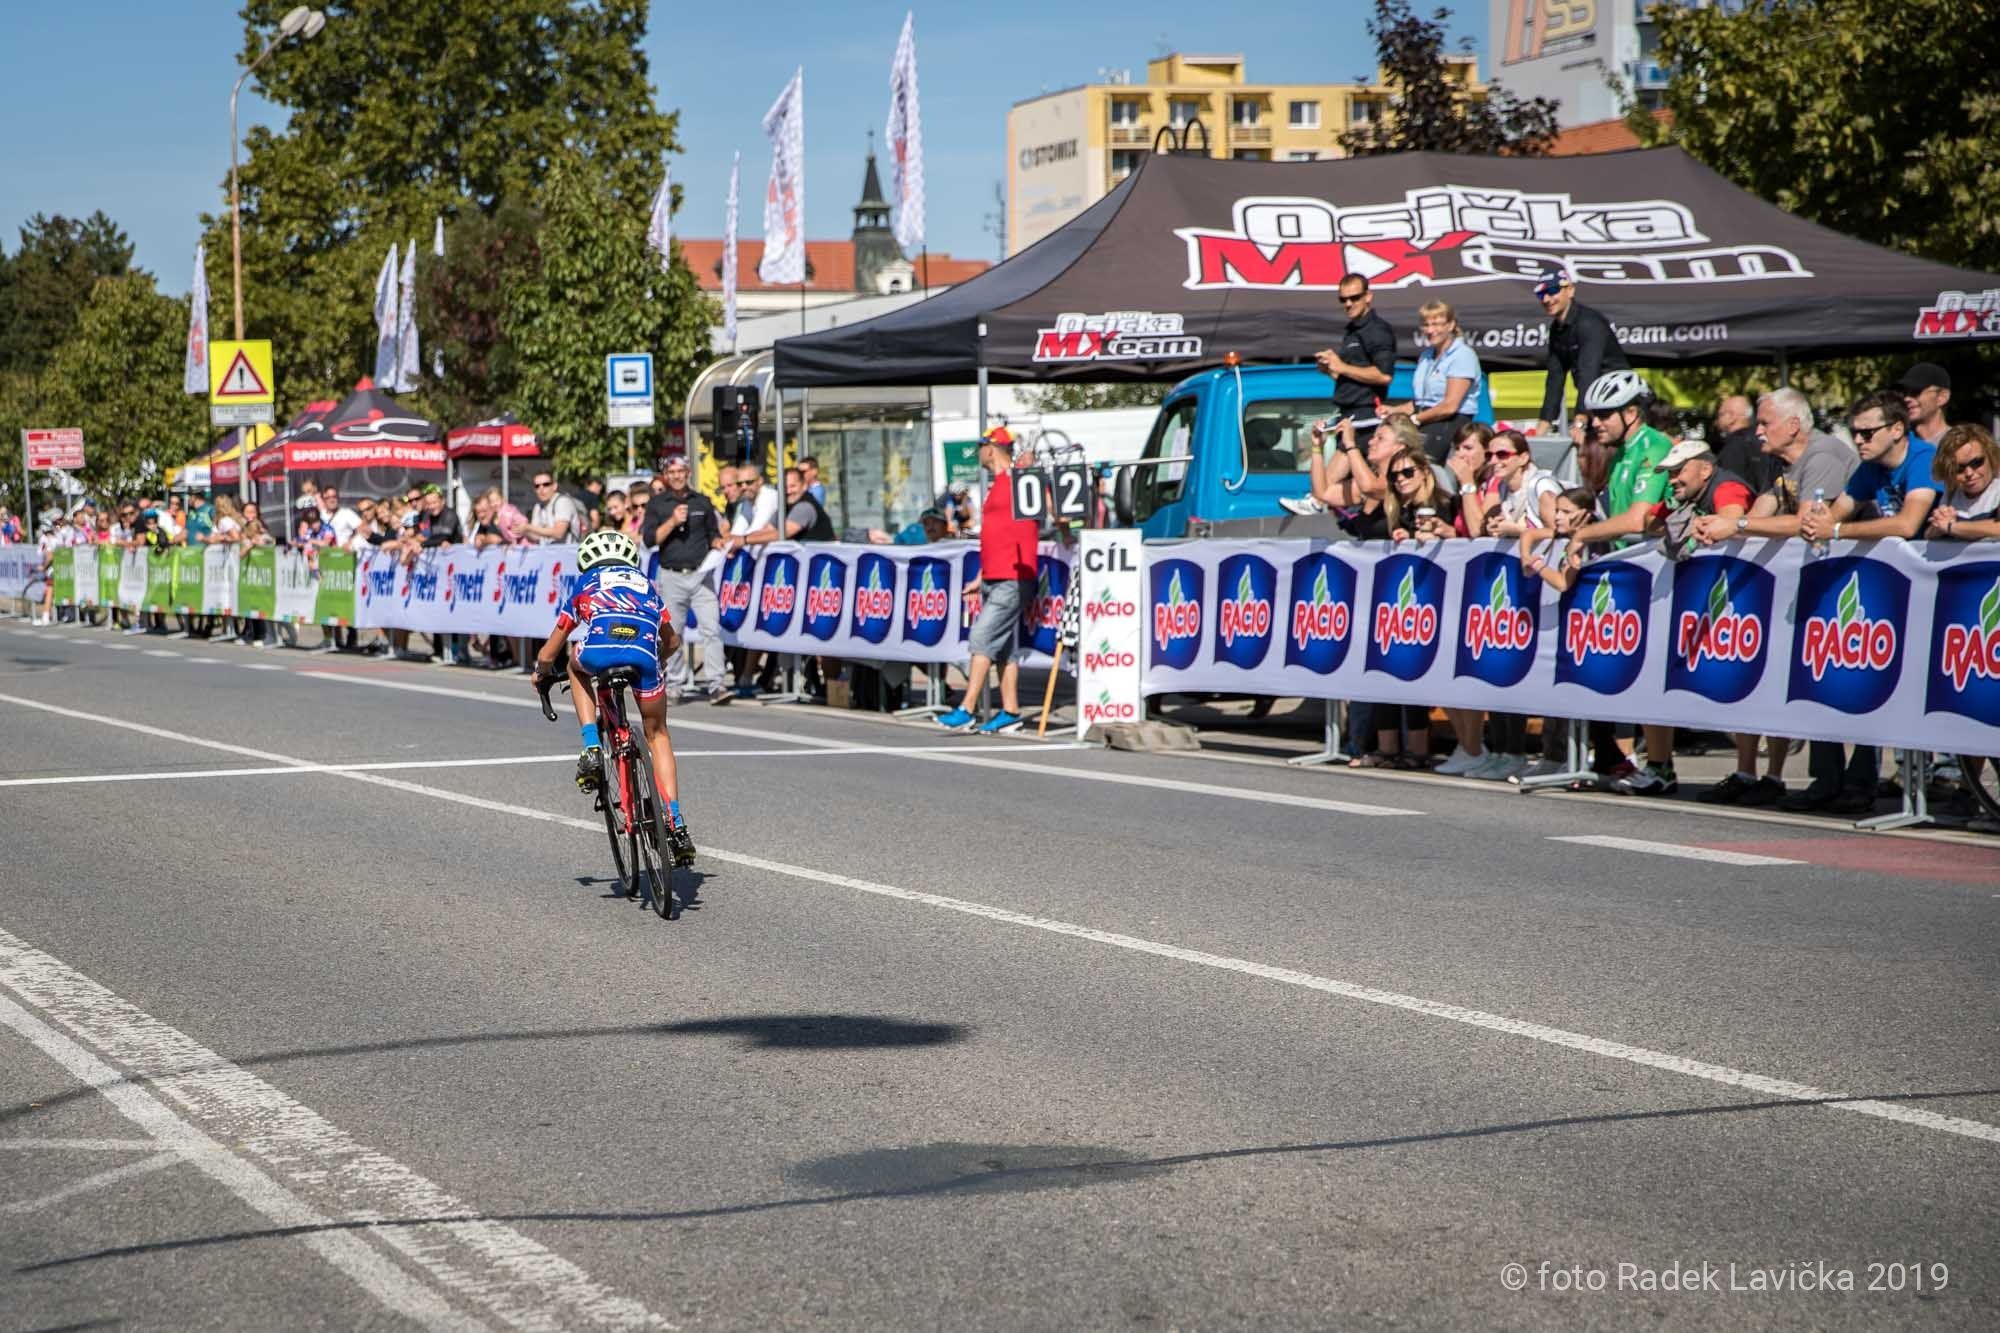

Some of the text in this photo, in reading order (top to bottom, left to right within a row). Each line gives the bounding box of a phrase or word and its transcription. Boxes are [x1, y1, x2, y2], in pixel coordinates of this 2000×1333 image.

[1238, 187, 1703, 248] Osička
[292, 447, 392, 462] SPORTCOMPLEX
[1018, 471, 1084, 516] 0 2
[1085, 542, 1136, 572] CÍL
[761, 584, 795, 621] RACIO
[807, 586, 842, 624] RACIO
[856, 587, 893, 626] RACIO
[908, 588, 947, 629] RACIO
[1086, 602, 1135, 623] RACIO
[1223, 600, 1270, 647] RACIO
[1155, 601, 1199, 650] RACIO
[1294, 601, 1349, 650] RACIO
[1375, 603, 1436, 656] RACIO
[1466, 605, 1533, 660] RACIO
[1567, 609, 1641, 666] RACIO
[1679, 611, 1762, 672] RACIO
[1085, 652, 1134, 672] RACIO
[1803, 617, 1896, 681] RACIO
[1084, 703, 1133, 722] RACIO
